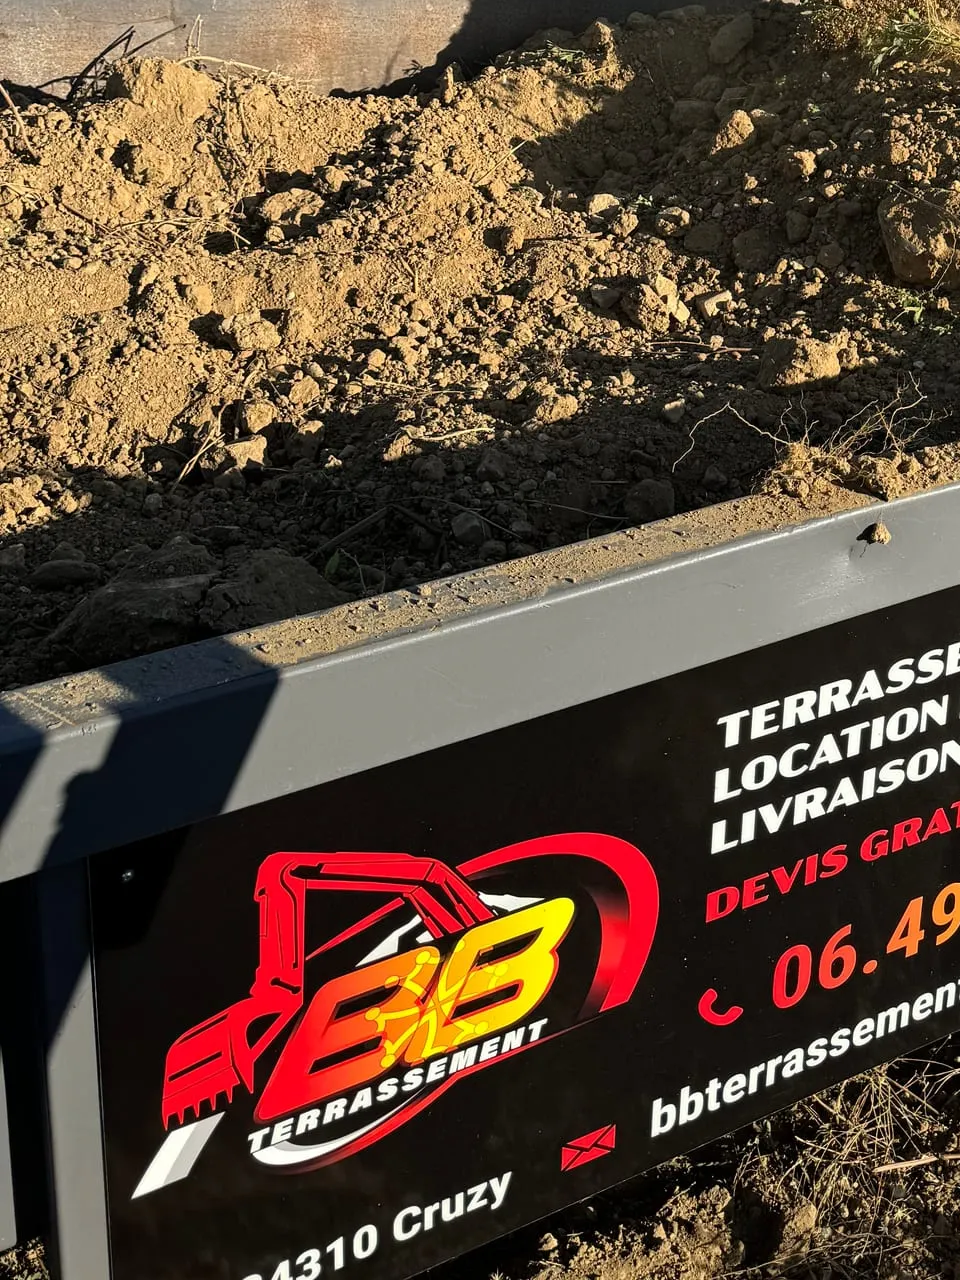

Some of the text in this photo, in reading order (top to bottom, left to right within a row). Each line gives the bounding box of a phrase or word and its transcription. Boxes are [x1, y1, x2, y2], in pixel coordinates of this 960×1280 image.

[713, 695, 949, 803] LOCATION
[705, 844, 849, 924] DEVIS
[247, 1018, 549, 1154] TERRASSEMENT
[242, 1171, 513, 1280] 4310 Cruzy
